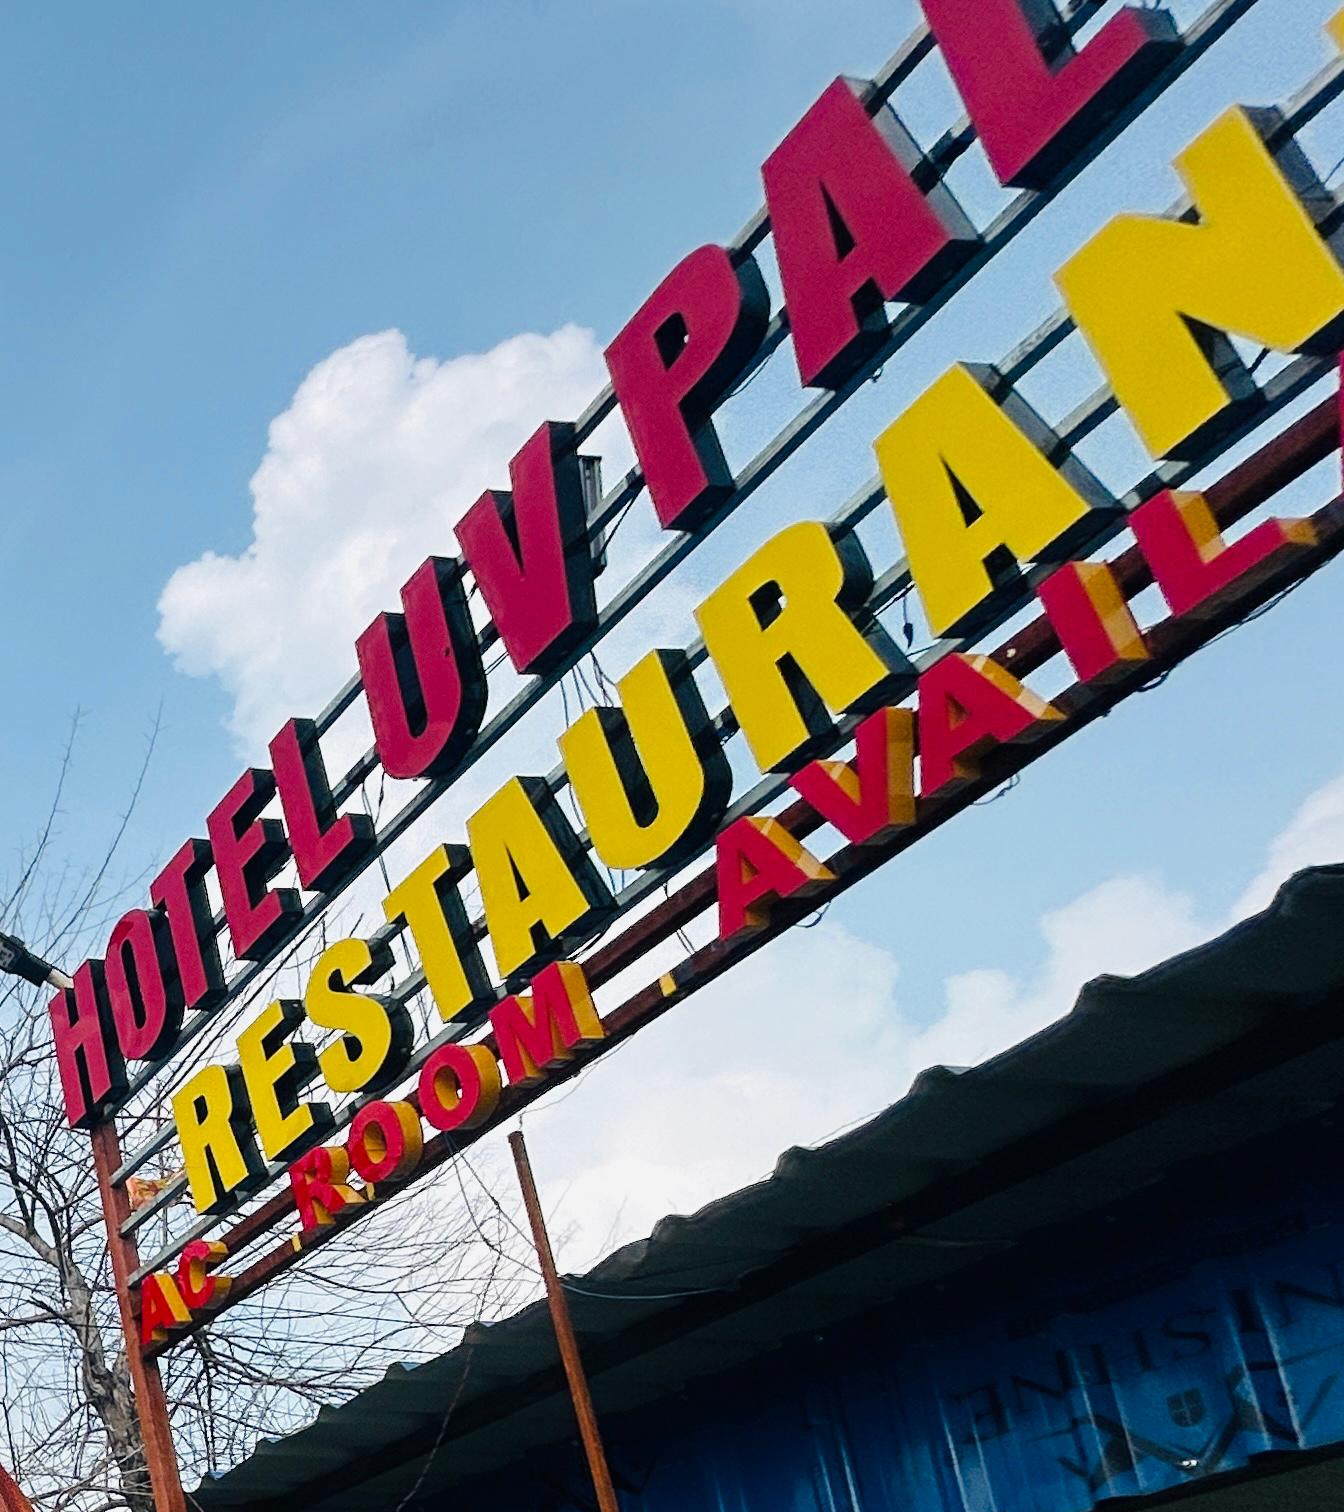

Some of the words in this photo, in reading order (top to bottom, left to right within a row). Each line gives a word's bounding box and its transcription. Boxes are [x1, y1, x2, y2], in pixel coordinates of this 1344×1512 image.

[49, 718, 374, 1130] HOTEL
[355, 420, 594, 780] UV
[603, 0, 1162, 532] PAL
[141, 1238, 231, 1346] AC
[289, 960, 604, 1233] ROOM
[715, 349, 1344, 943] AVAIL
[172, 6, 1344, 1216] RESTAURAN
